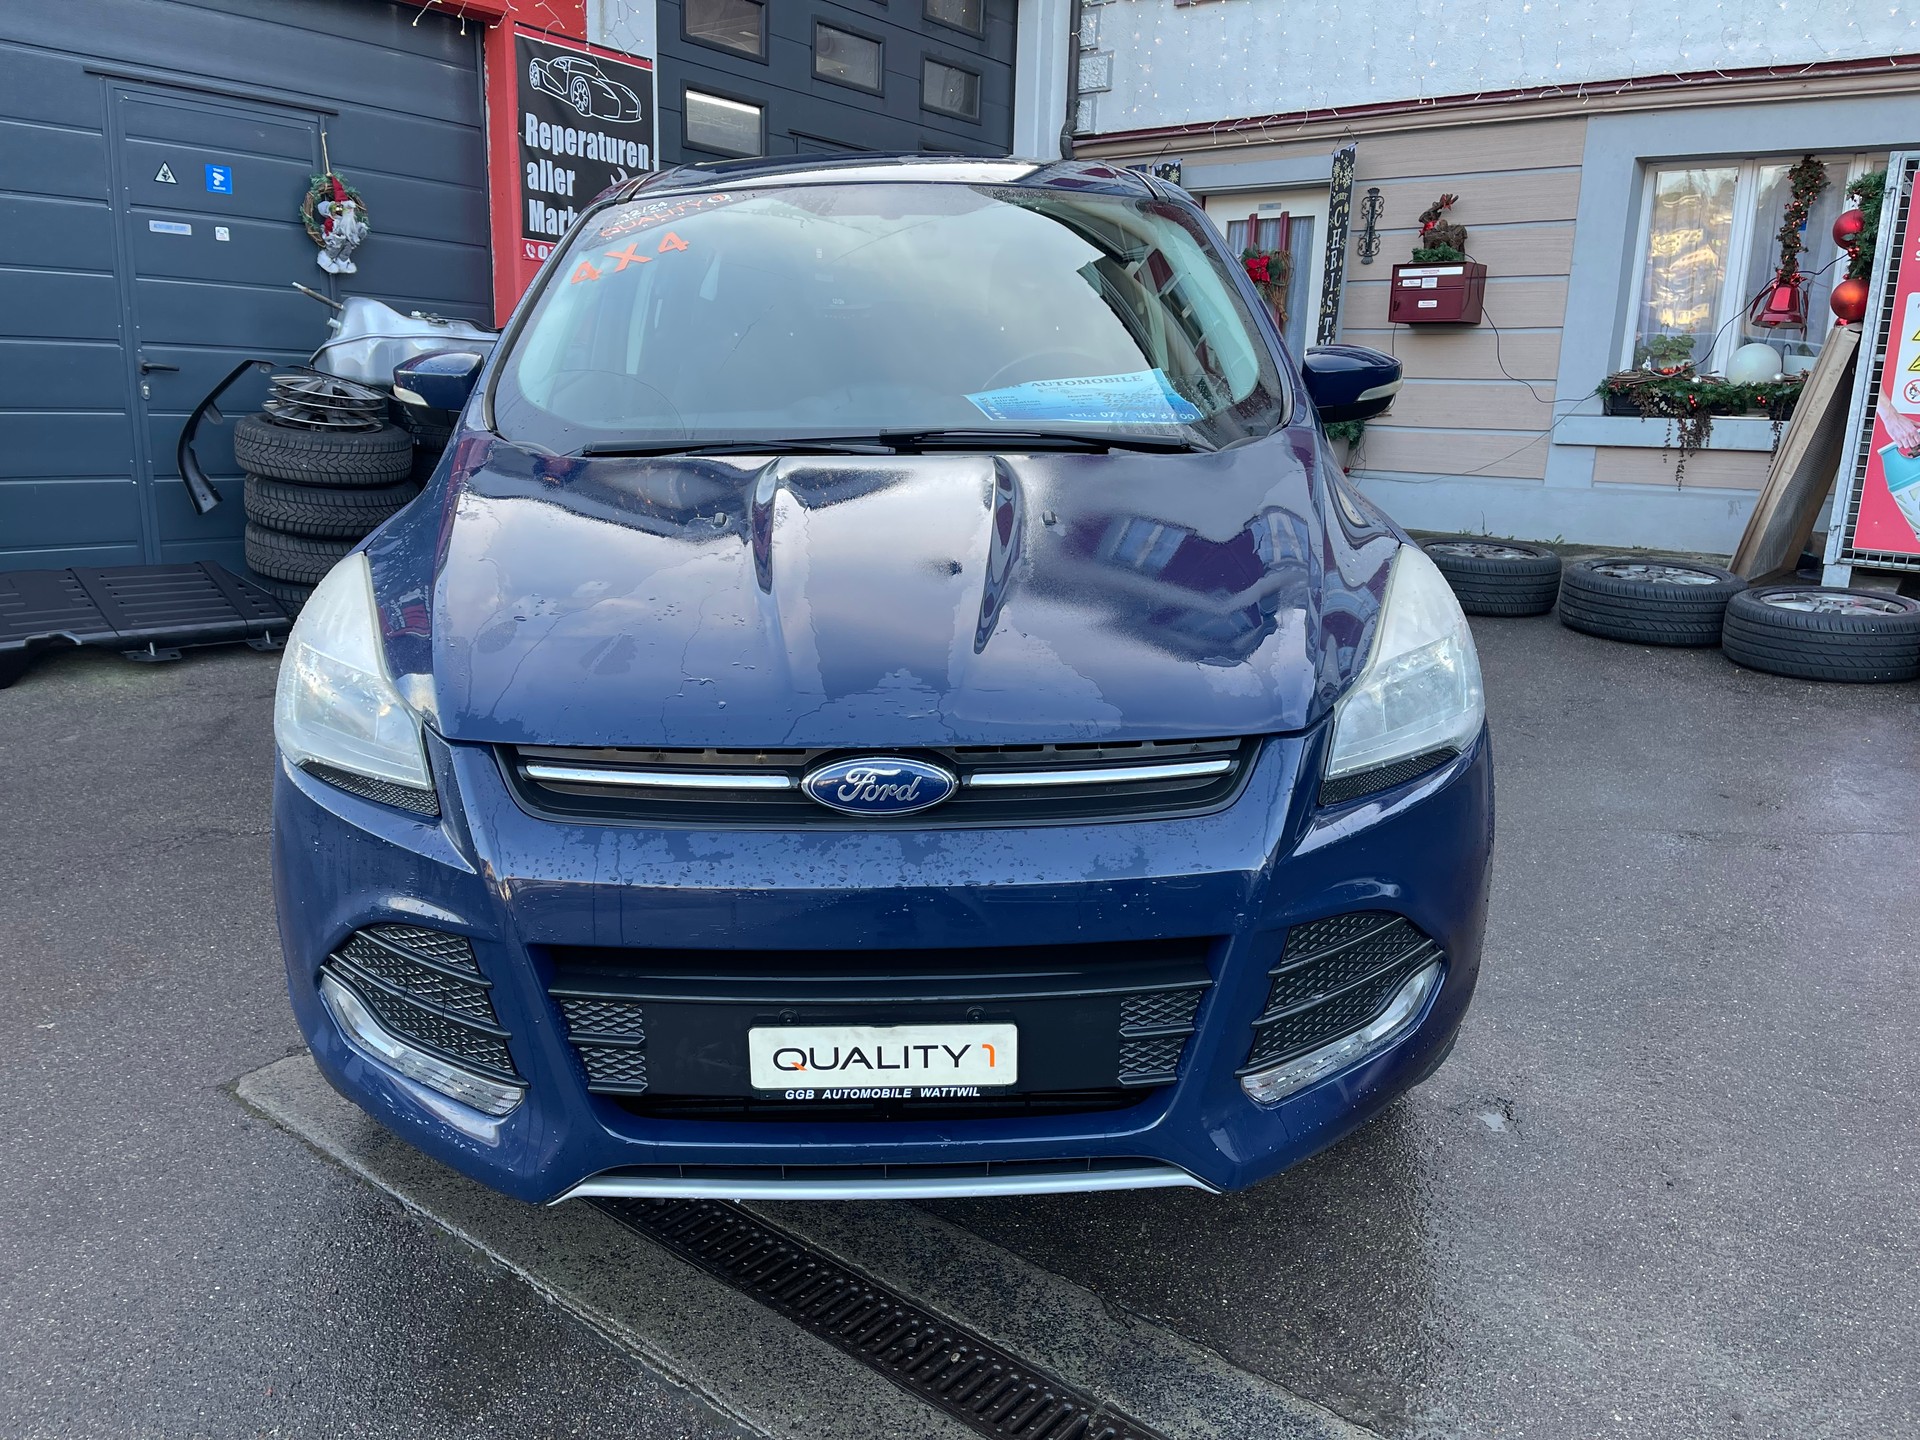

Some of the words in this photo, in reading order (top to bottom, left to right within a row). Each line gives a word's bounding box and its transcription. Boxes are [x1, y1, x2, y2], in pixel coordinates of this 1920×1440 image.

[525, 112, 650, 170] Reperaturen
[526, 158, 576, 197] aller
[600, 200, 702, 237] QUALITY
[620, 201, 668, 219] 12/24
[1031, 375, 1144, 388] AUTOMOBILE
[837, 767, 923, 802] Ford
[772, 1044, 972, 1071] QUALITY
[784, 1089, 815, 1100] GGB
[821, 1088, 912, 1100] AUTOMOBILE
[919, 1087, 981, 1098] WATTWIL
